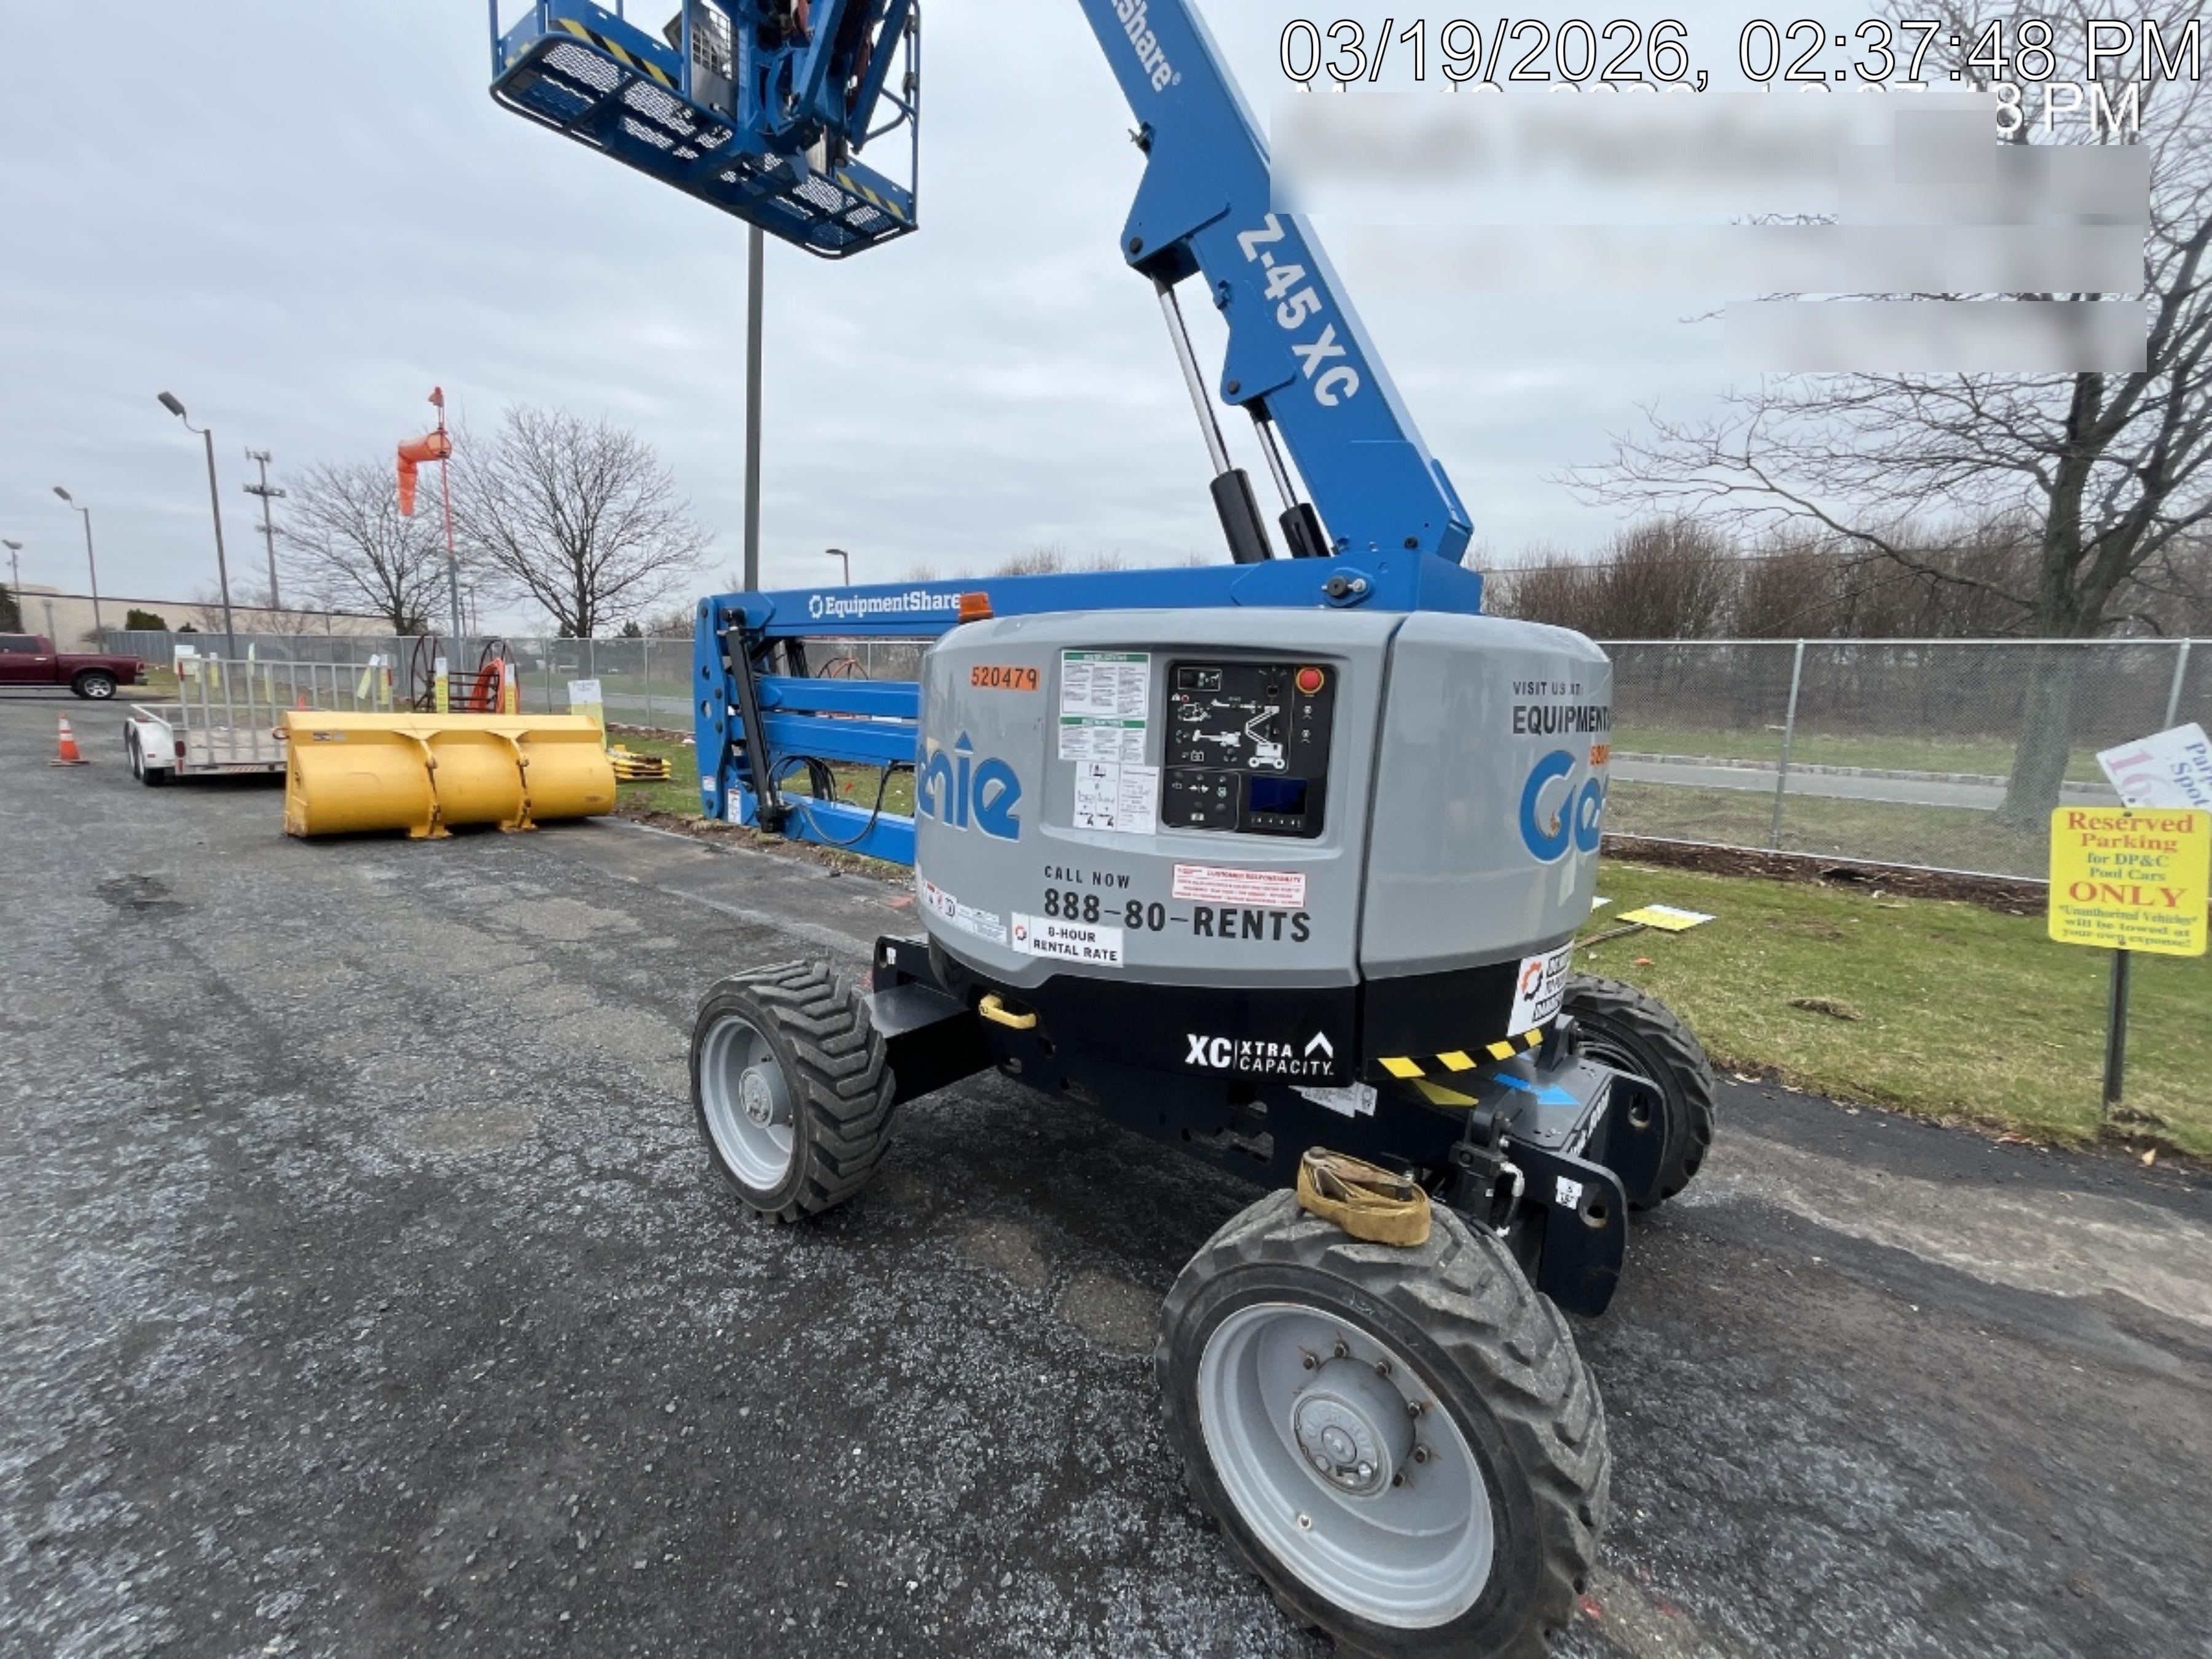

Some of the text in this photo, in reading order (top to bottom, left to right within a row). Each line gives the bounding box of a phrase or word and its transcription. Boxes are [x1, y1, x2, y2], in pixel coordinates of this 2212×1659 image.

[1236, 213, 1359, 407] Z-45 XC
[825, 591, 961, 618] EquipmentShare
[971, 666, 1038, 690] 520479
[1513, 681, 1547, 695] VISIT
[1552, 682, 1566, 695] US
[2170, 762, 2210, 807] Spot
[1518, 749, 1610, 865] Ge
[2067, 811, 2194, 833] Reserved
[2081, 833, 2178, 853] Parking
[2087, 852, 2169, 867] for DP&C
[1045, 866, 1130, 889] CALL NOW
[2090, 866, 2166, 881] Pool Cars
[2069, 881, 2187, 908] ONLY
[1044, 888, 1311, 943] 888-80-RENTS
[2065, 918, 2091, 927] will
[2096, 920, 2114, 929] be
[2120, 924, 2168, 935] towed
[2063, 928, 2092, 937] your
[2097, 931, 2125, 941] own
[1033, 940, 1118, 961] RENTAL RATE
[1185, 1033, 1232, 1068] XC
[1240, 1041, 1292, 1058] XTRA
